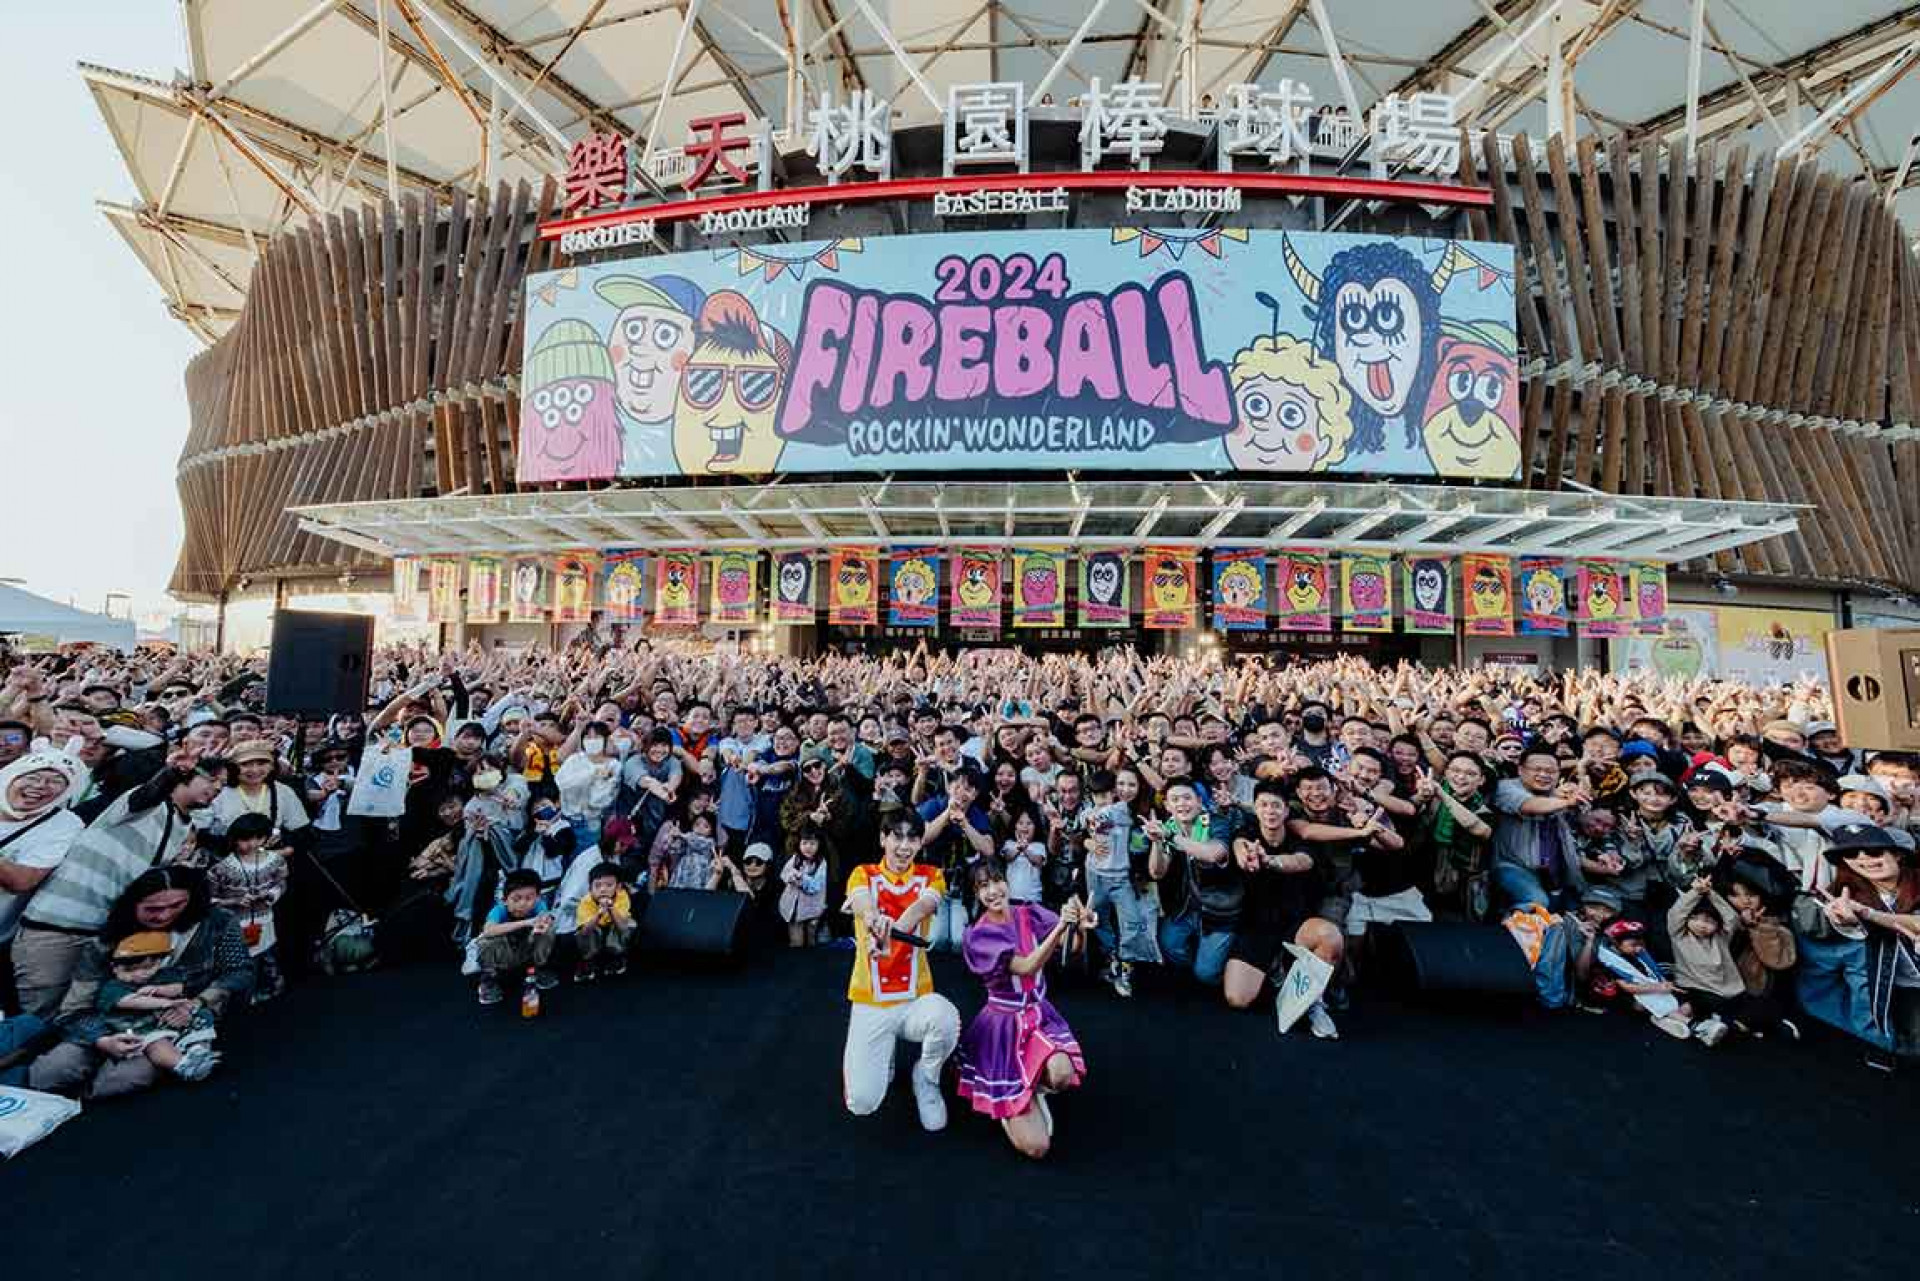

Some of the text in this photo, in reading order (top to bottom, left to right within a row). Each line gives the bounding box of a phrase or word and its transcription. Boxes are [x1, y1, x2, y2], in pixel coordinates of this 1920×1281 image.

[564, 76, 1461, 212] 樂天桃園棒球場
[560, 186, 1242, 253] RAKUTEN TAOYUAN BASEBALL STADIUM
[935, 253, 1071, 301] 2024
[780, 275, 1233, 434] FIREBALL
